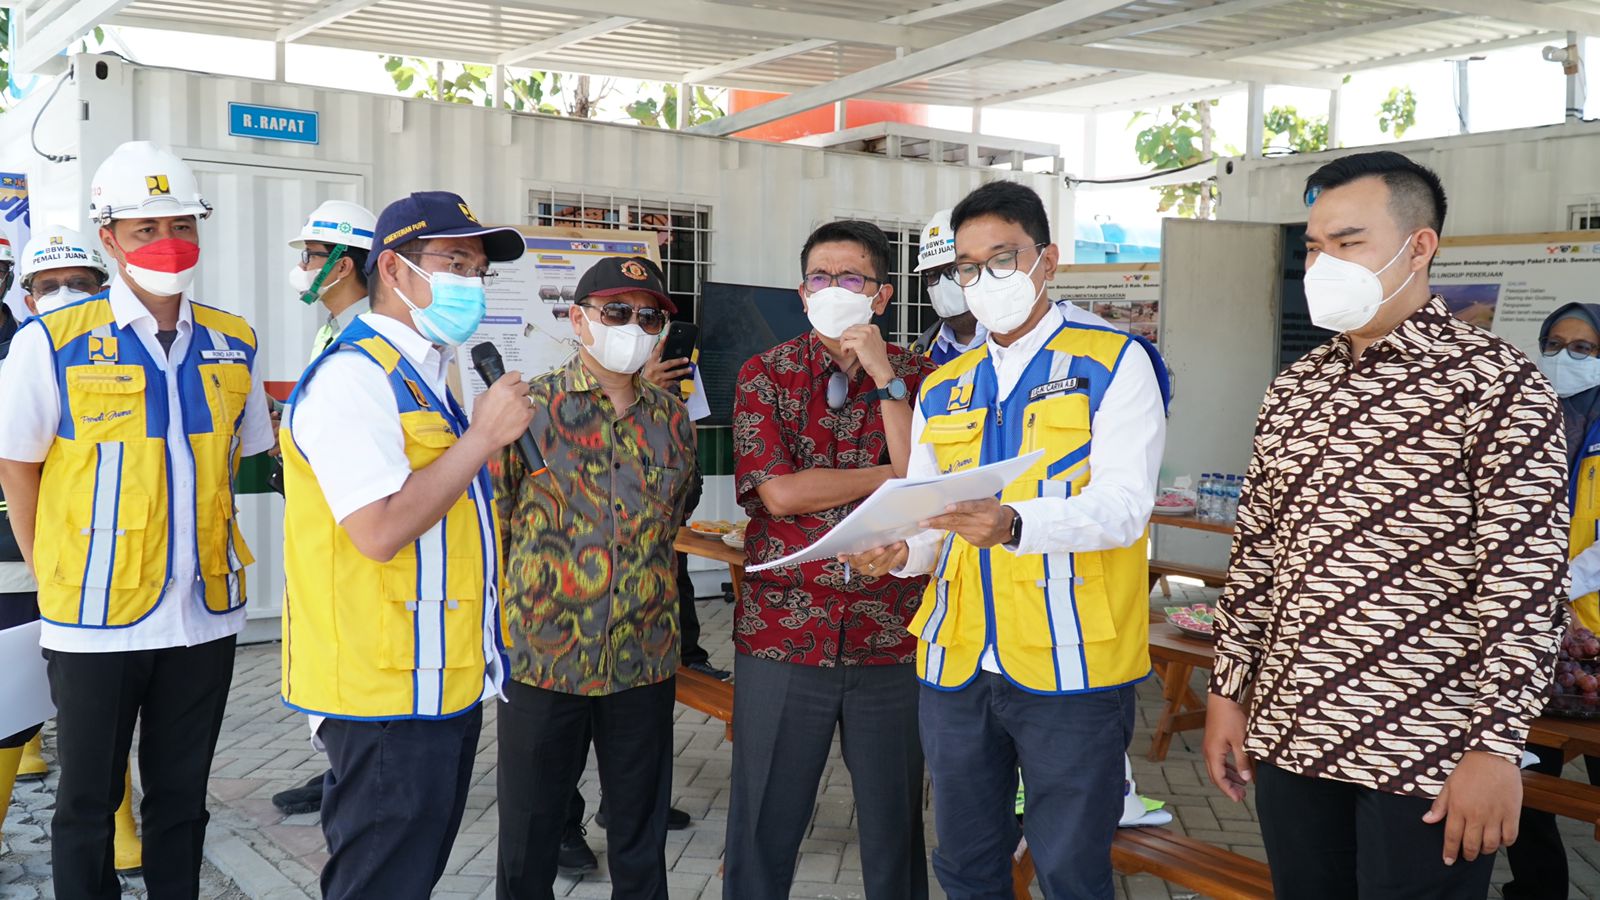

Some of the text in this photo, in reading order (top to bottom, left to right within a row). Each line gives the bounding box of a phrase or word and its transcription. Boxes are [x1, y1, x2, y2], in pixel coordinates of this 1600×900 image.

[243, 113, 305, 134] R.RAPAT
[45, 245, 71, 253] BBWS
[33, 254, 61, 264] PEMALI
